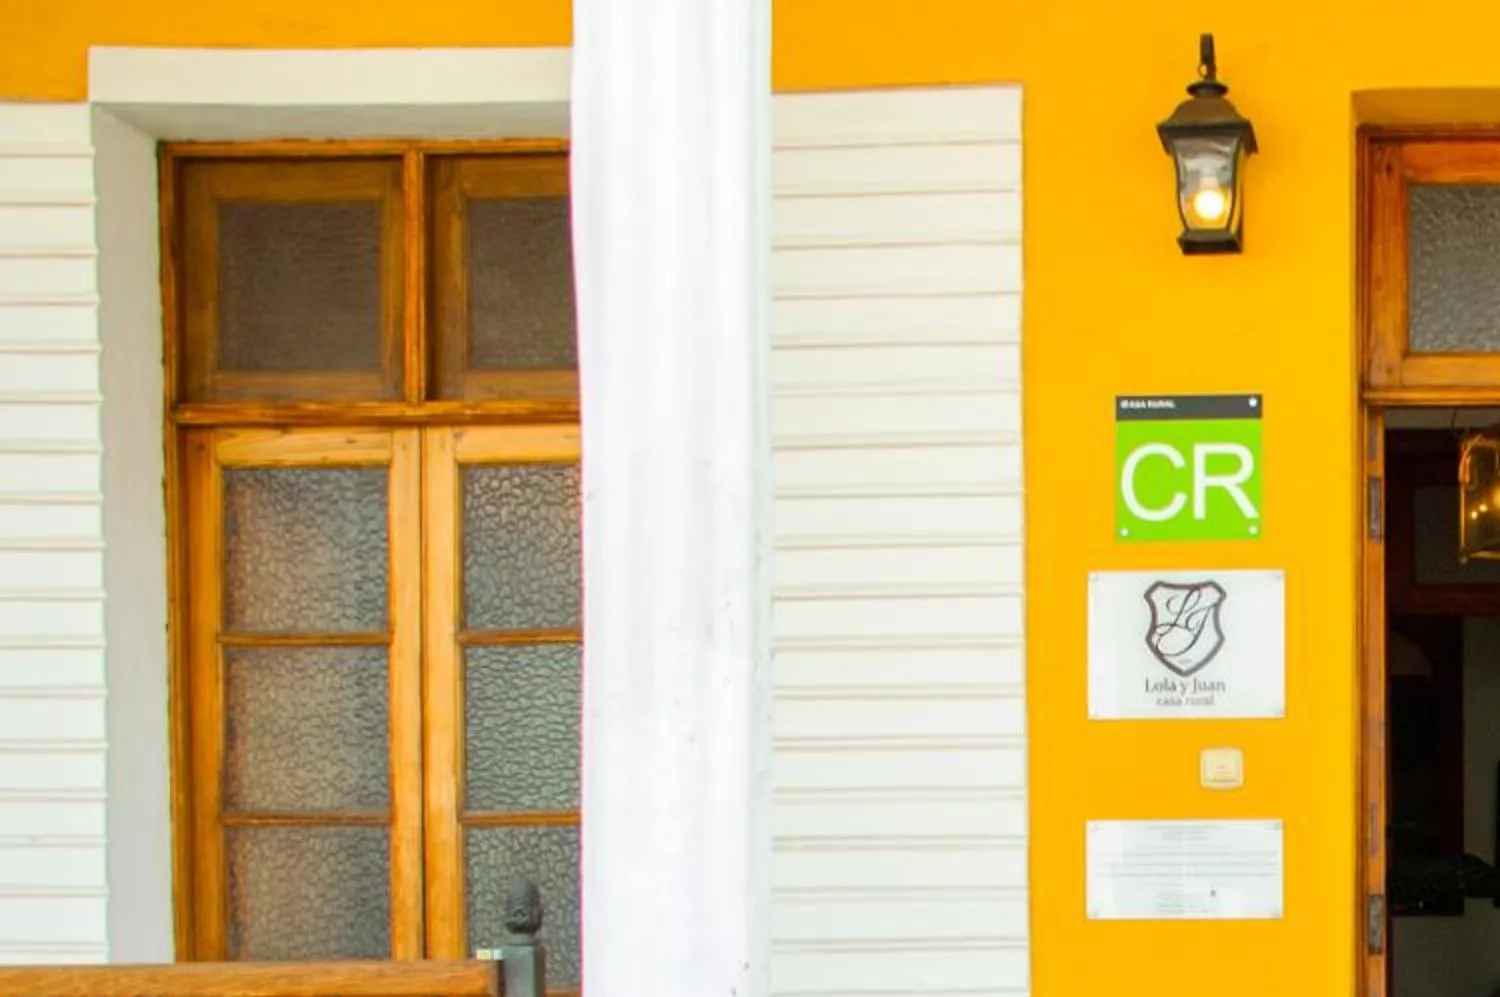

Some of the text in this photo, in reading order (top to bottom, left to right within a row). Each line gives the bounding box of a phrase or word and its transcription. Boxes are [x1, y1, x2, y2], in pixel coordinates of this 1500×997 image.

[1121, 442, 1260, 521] CR
[1145, 677, 1226, 697] Lola y Juan
[1156, 697, 1183, 706] casa
